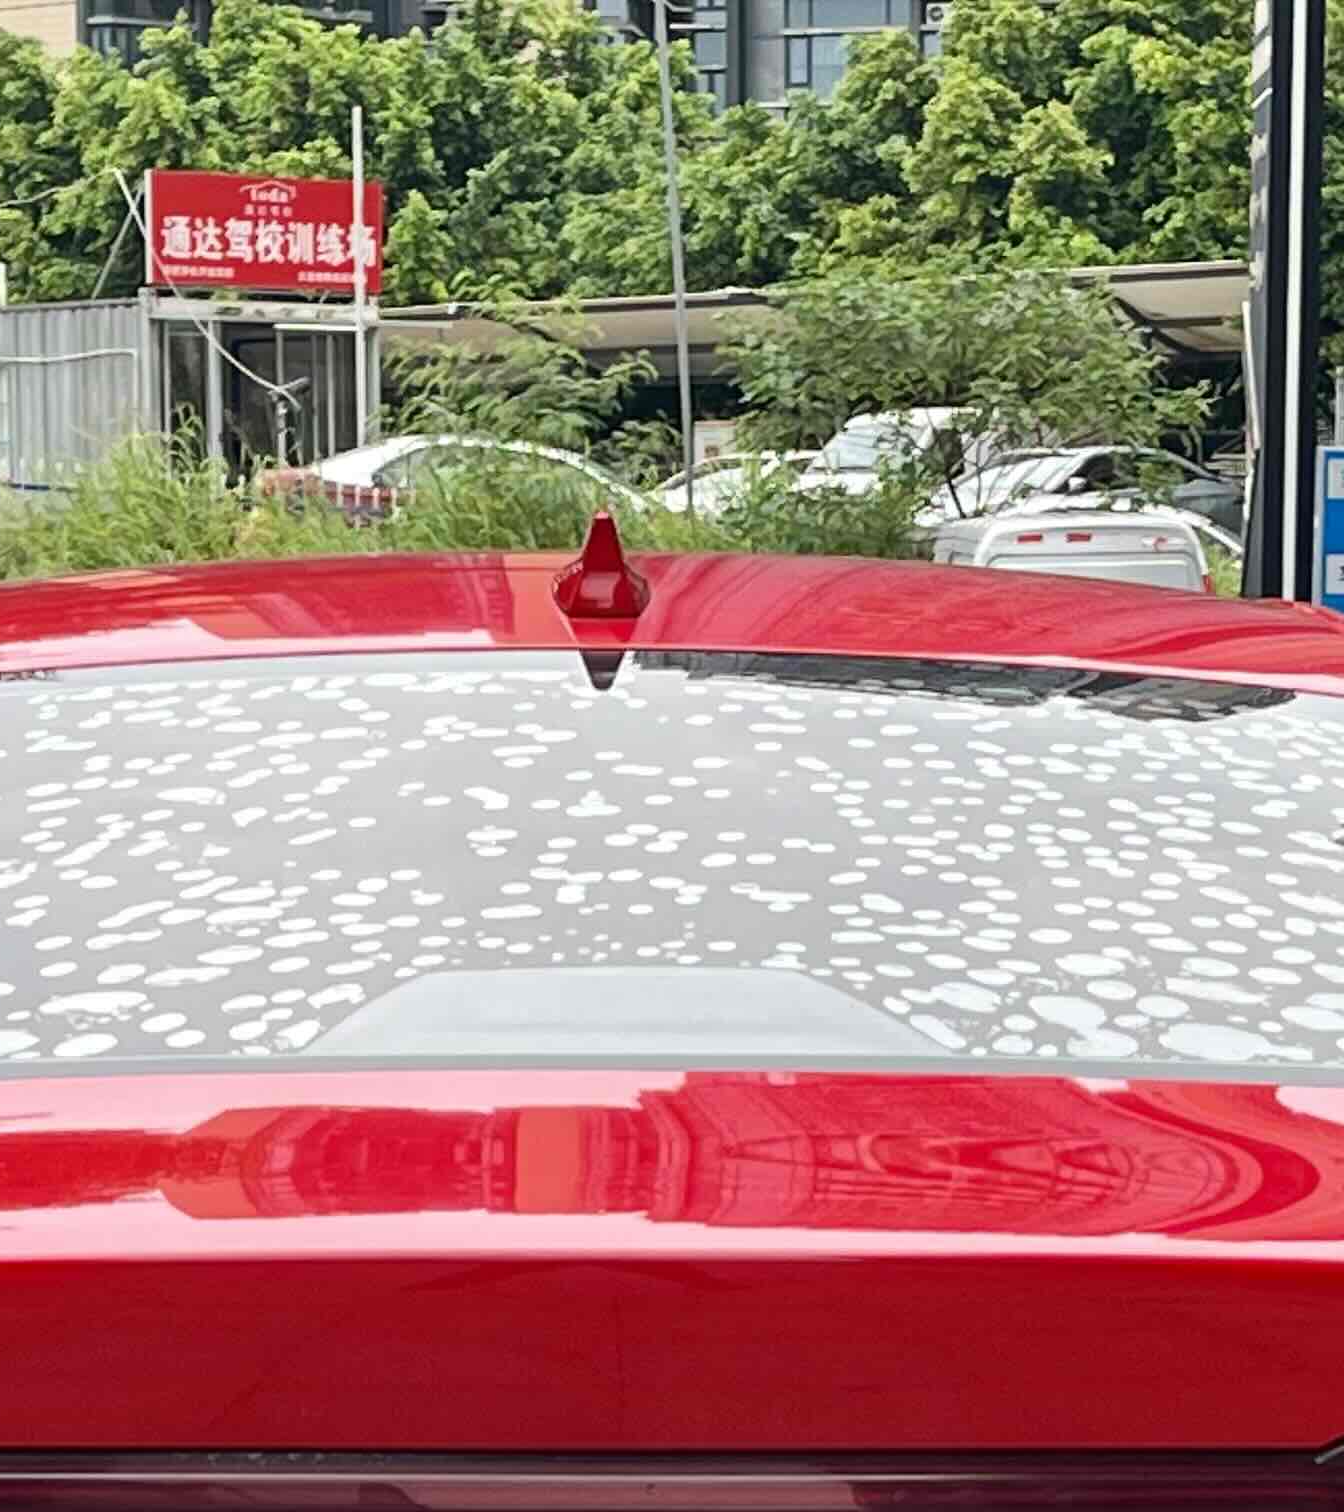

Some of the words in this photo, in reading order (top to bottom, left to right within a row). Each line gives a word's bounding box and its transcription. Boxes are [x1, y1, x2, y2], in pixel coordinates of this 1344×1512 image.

[160, 215, 377, 267] 通达驾校训练场
